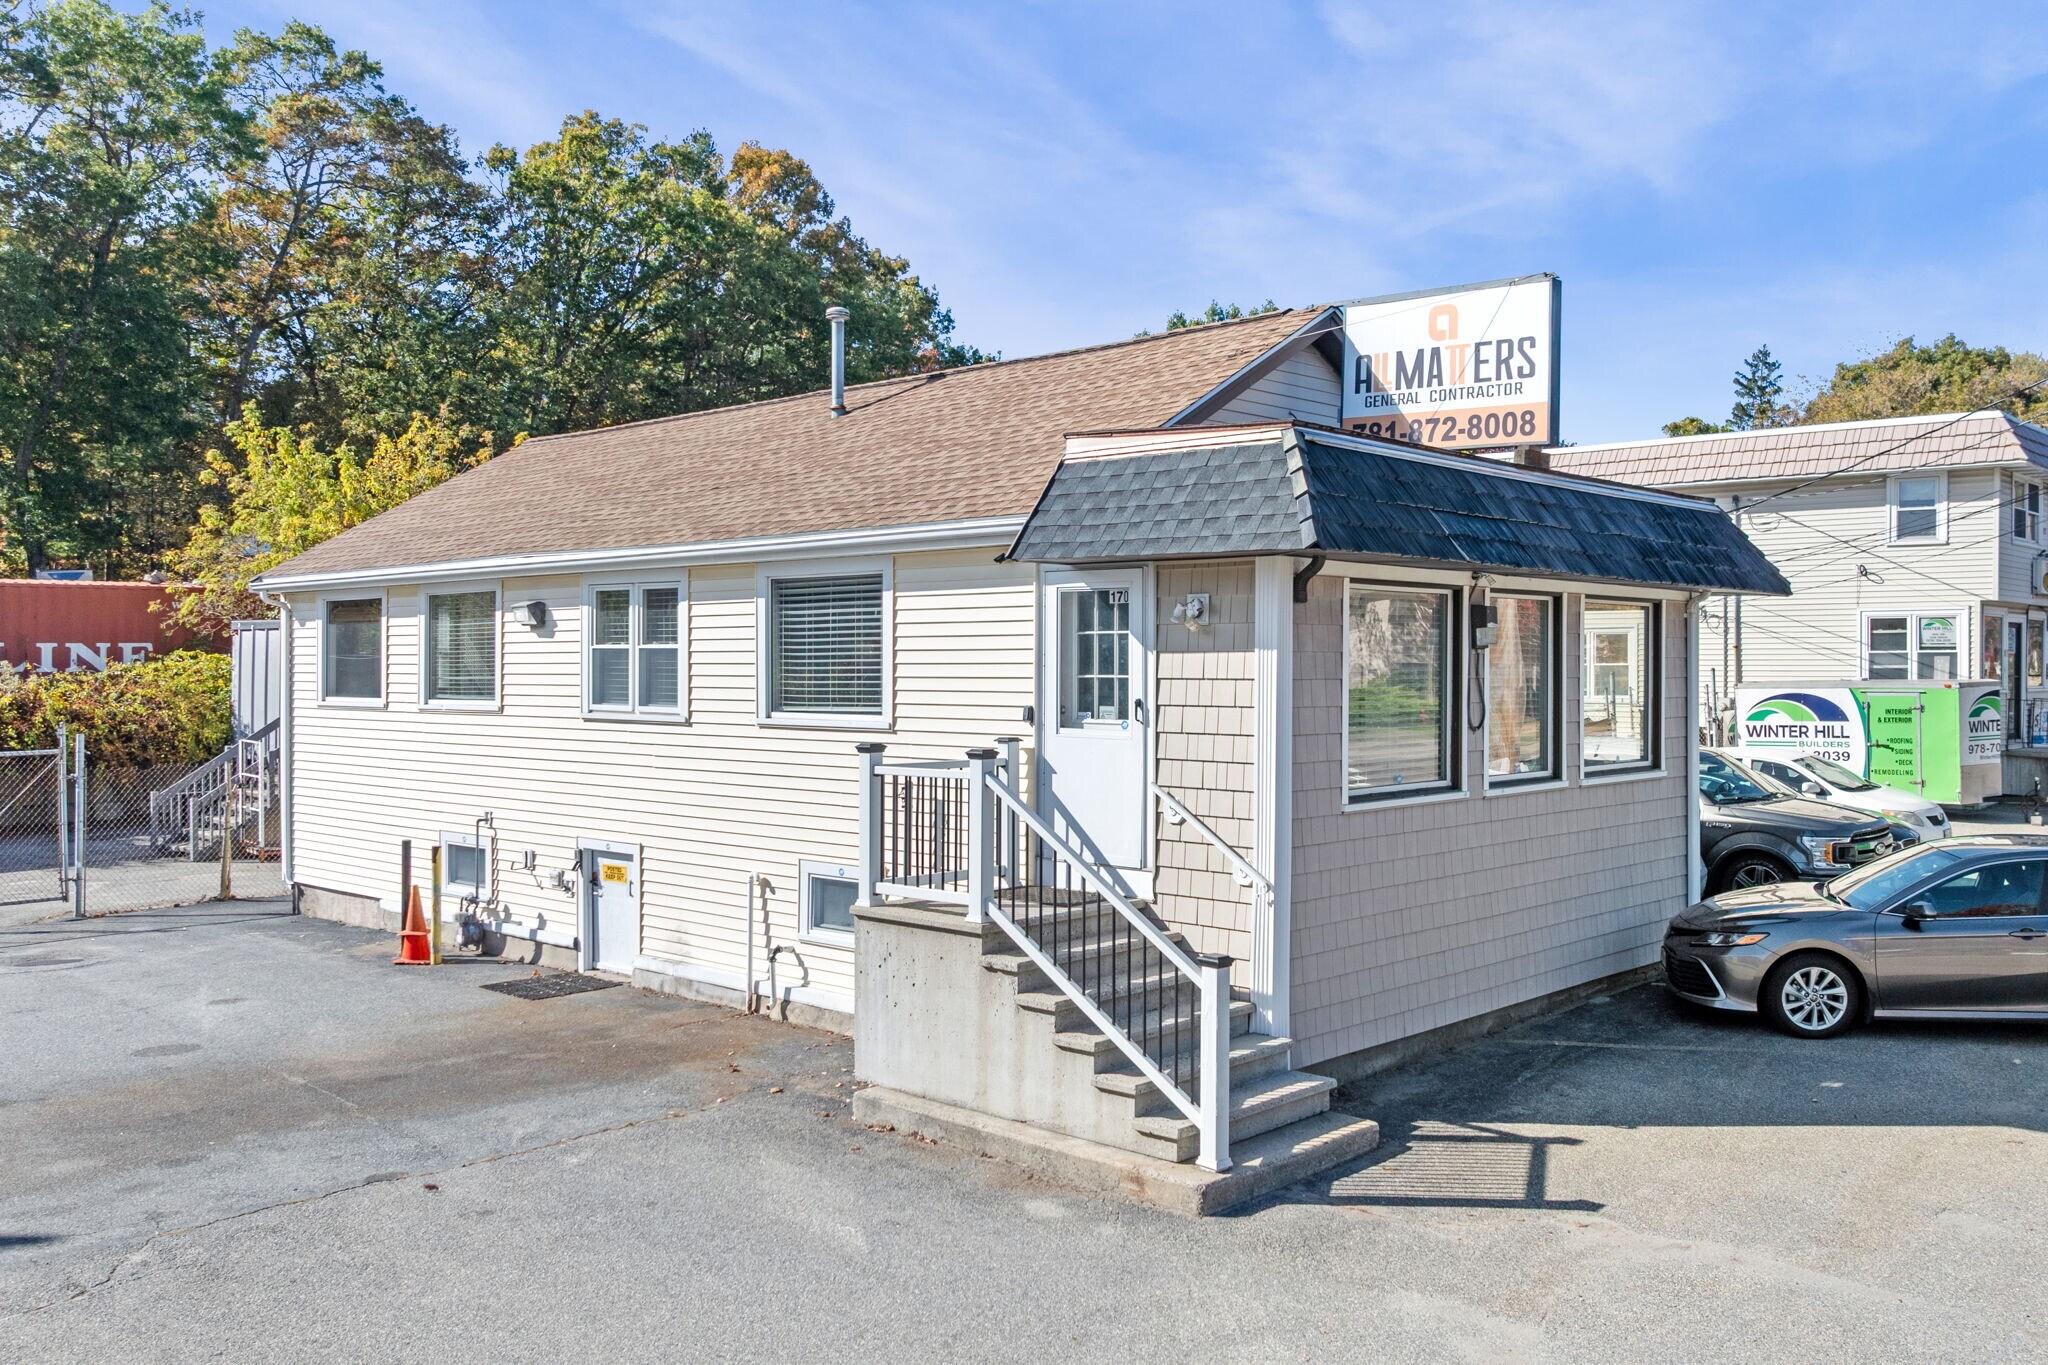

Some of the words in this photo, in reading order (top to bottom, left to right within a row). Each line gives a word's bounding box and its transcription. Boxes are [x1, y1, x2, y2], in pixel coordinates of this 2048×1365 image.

[1355, 336, 1536, 394] ALLMATTERS
[1364, 391, 1421, 408] GENERAL
[1429, 382, 1523, 402] CONTRACTOR
[1352, 410, 1536, 443] 781-872-8008
[1110, 590, 1129, 603] 170
[1746, 724, 1809, 738] WINTER
[1814, 725, 1850, 739] HILL
[1798, 740, 1851, 748] BUILDERS
